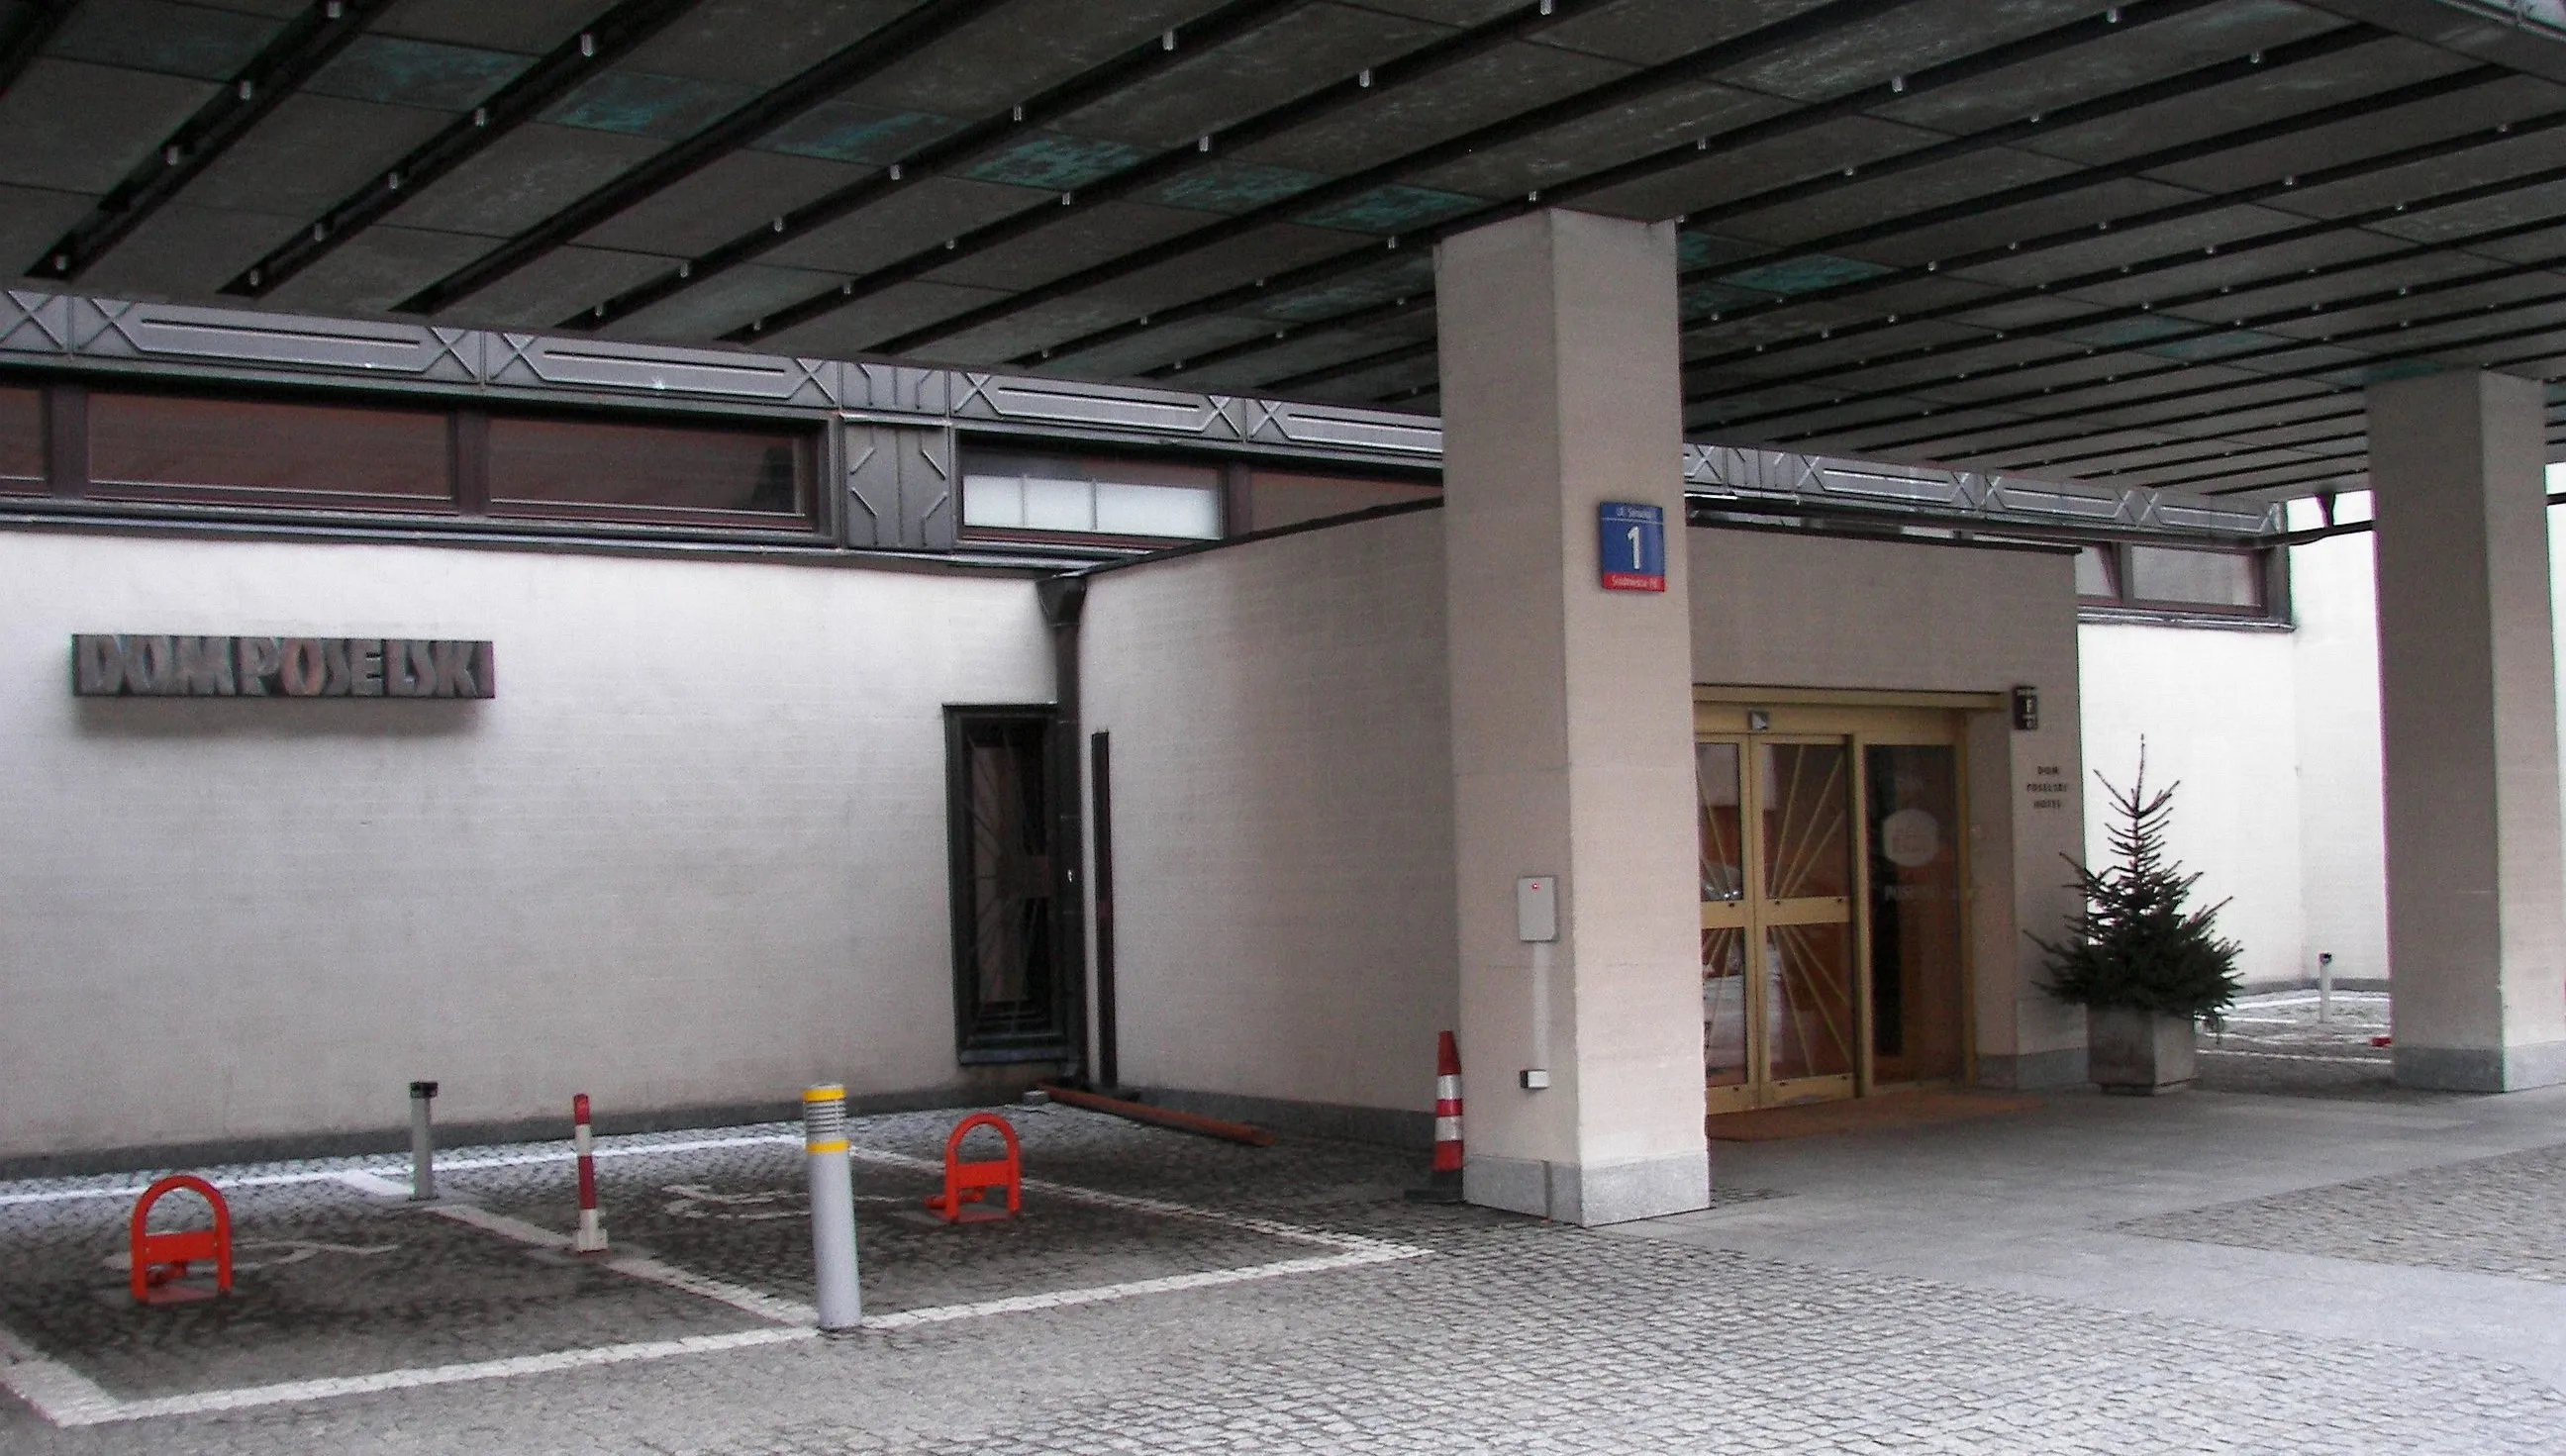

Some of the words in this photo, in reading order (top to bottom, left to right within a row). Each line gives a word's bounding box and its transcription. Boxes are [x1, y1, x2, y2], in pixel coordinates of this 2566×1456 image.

[1628, 526, 1640, 570] 1
[77, 635, 235, 696] DOM
[241, 637, 494, 698] POSELSKI
